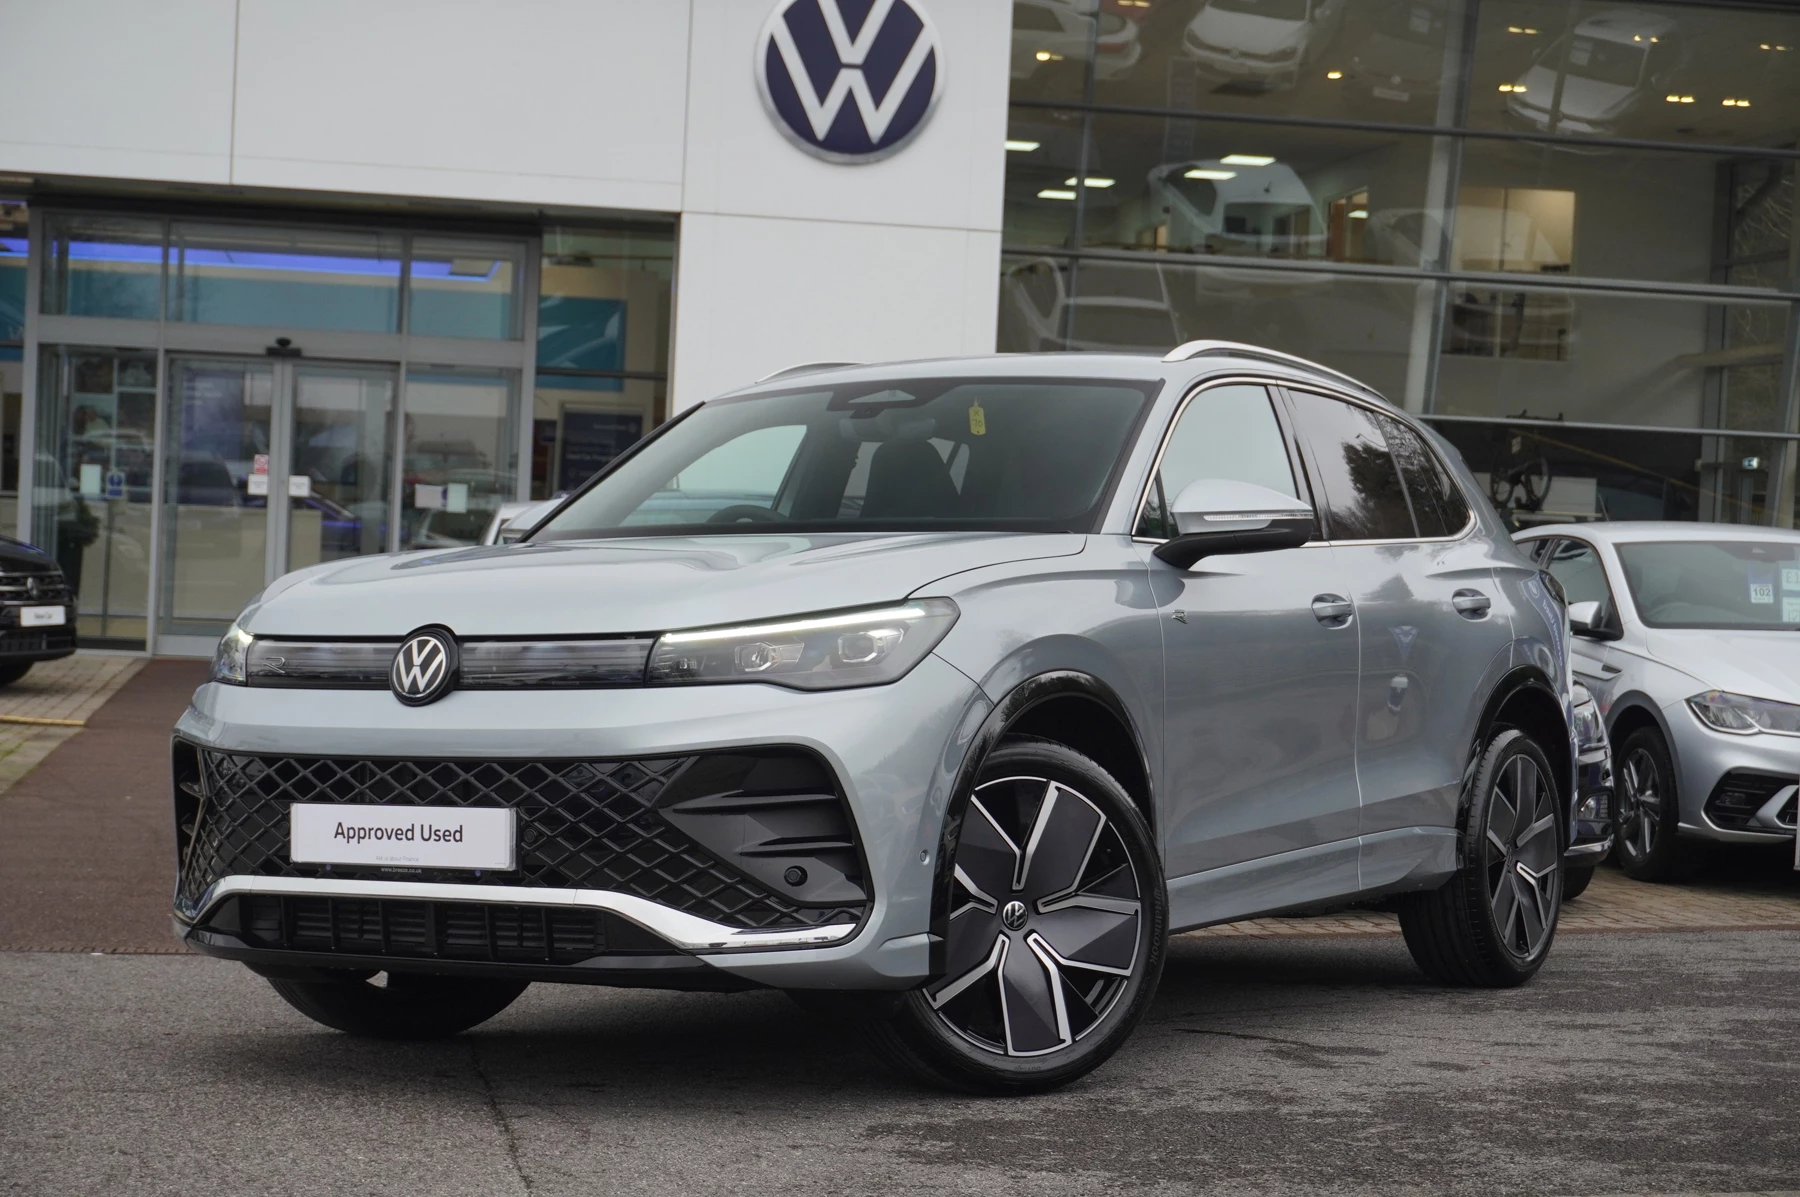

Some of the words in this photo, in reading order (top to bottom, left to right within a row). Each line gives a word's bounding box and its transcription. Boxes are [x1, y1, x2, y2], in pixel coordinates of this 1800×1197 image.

[763, 0, 940, 150] VW
[1752, 588, 1772, 597] 102
[396, 637, 446, 695] VW
[334, 821, 415, 845] Approved
[420, 824, 463, 843] Used
